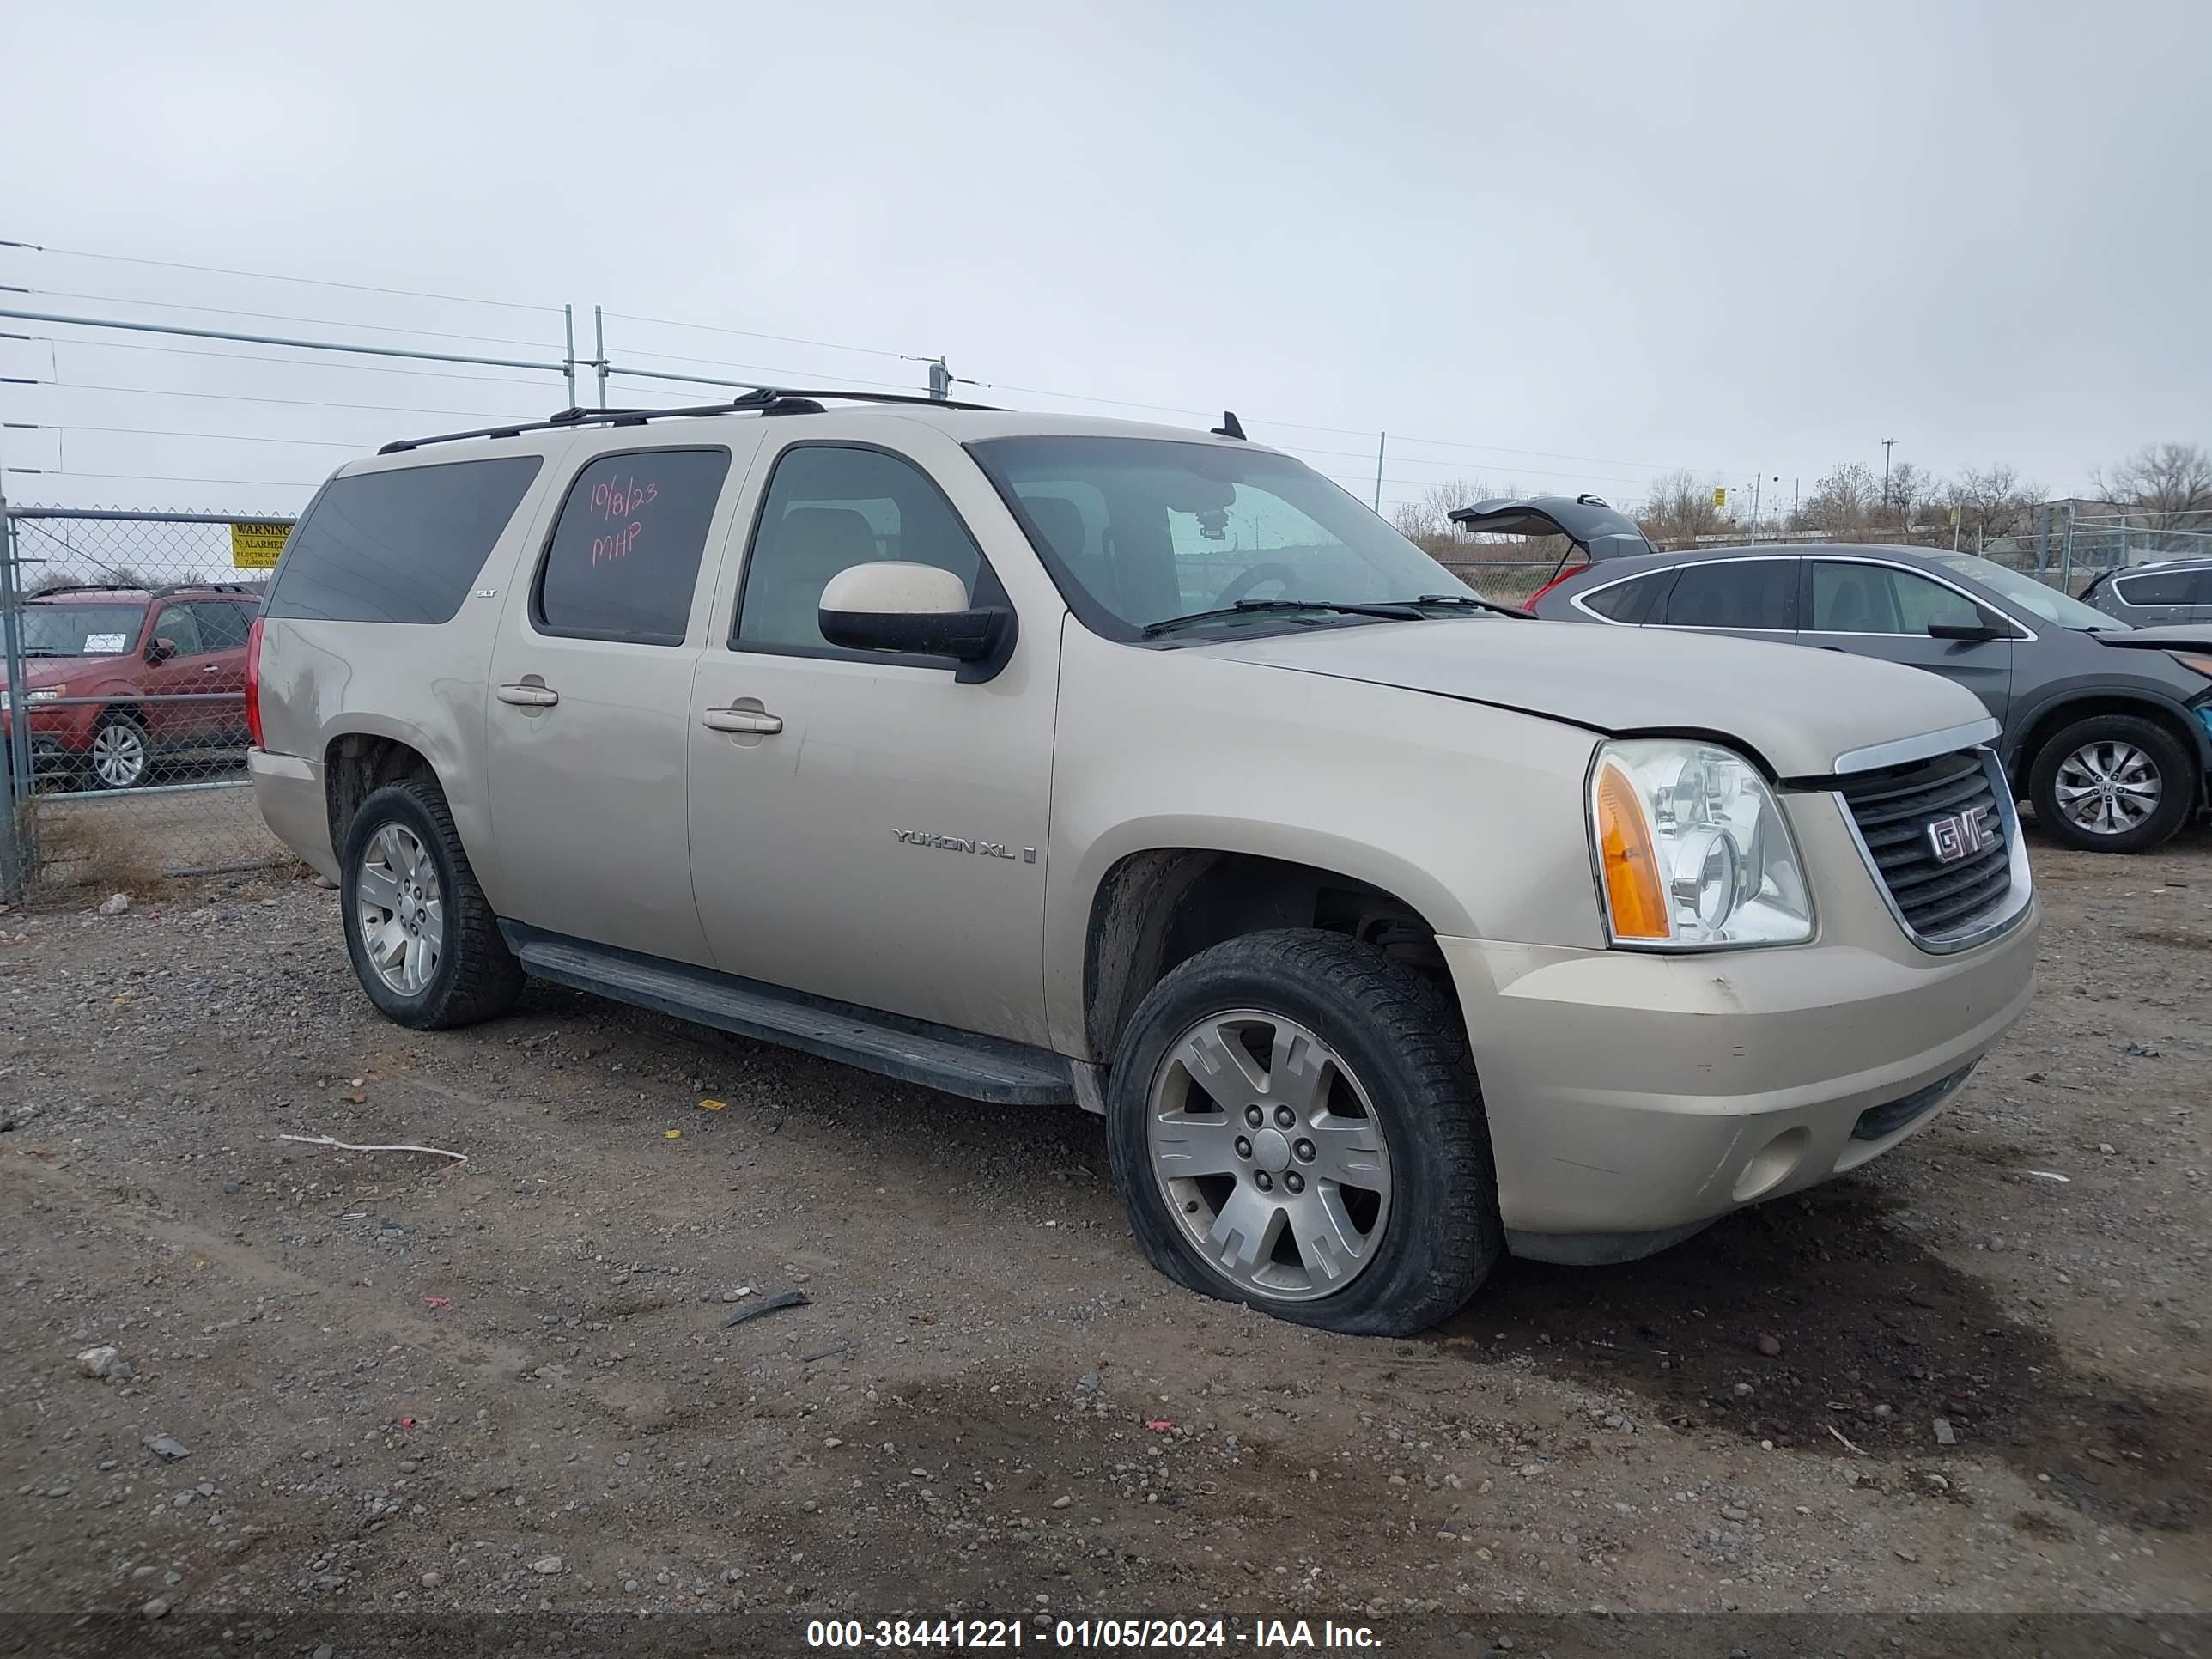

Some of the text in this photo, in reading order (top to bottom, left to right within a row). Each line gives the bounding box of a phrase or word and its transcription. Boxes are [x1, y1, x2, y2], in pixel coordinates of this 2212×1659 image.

[590, 475, 658, 521] 10/8/23
[236, 524, 291, 536] WARNING
[592, 521, 641, 567] MHP
[891, 827, 1016, 860] YUKON XL
[1928, 805, 1995, 863] GMC
